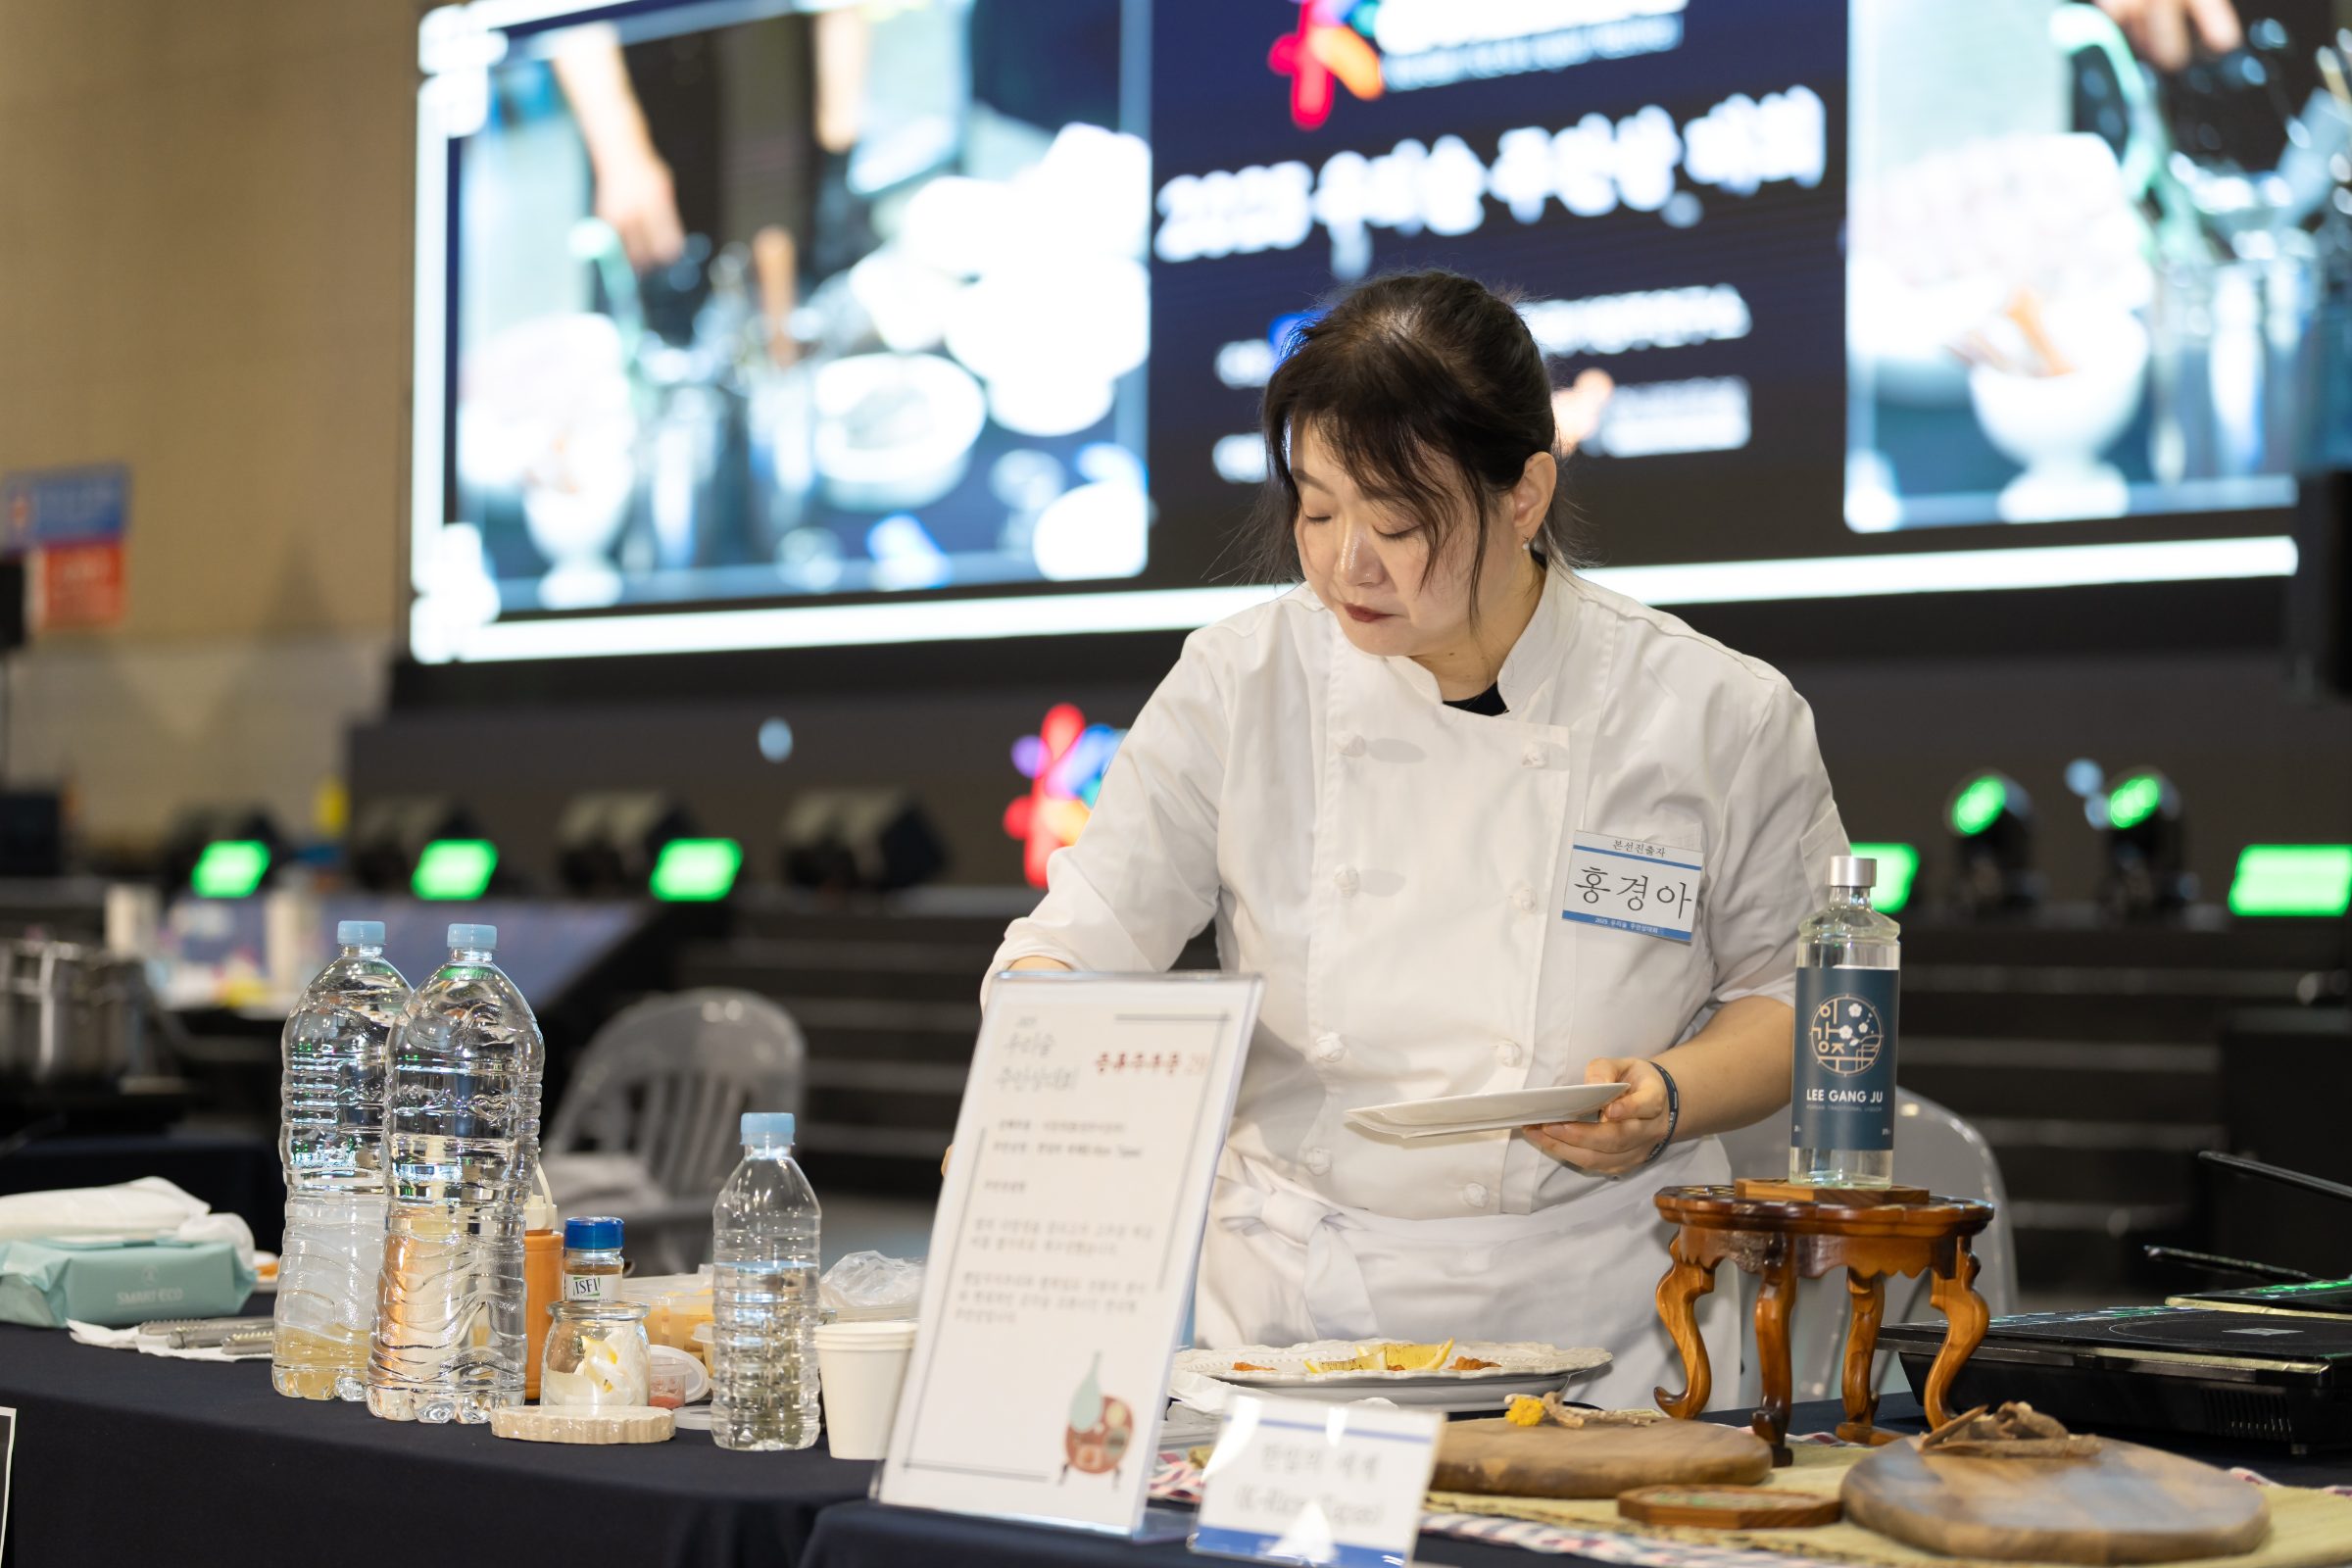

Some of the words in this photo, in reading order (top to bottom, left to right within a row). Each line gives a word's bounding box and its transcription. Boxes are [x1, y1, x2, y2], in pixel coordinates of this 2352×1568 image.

[1613, 840, 1666, 858] 본선진출자
[1574, 866, 1692, 919] 홍경아
[1806, 1089, 1825, 1102] LEE
[1828, 1090, 1867, 1103] GANG
[1870, 1091, 1884, 1103] JU
[574, 1278, 598, 1295] ISFI
